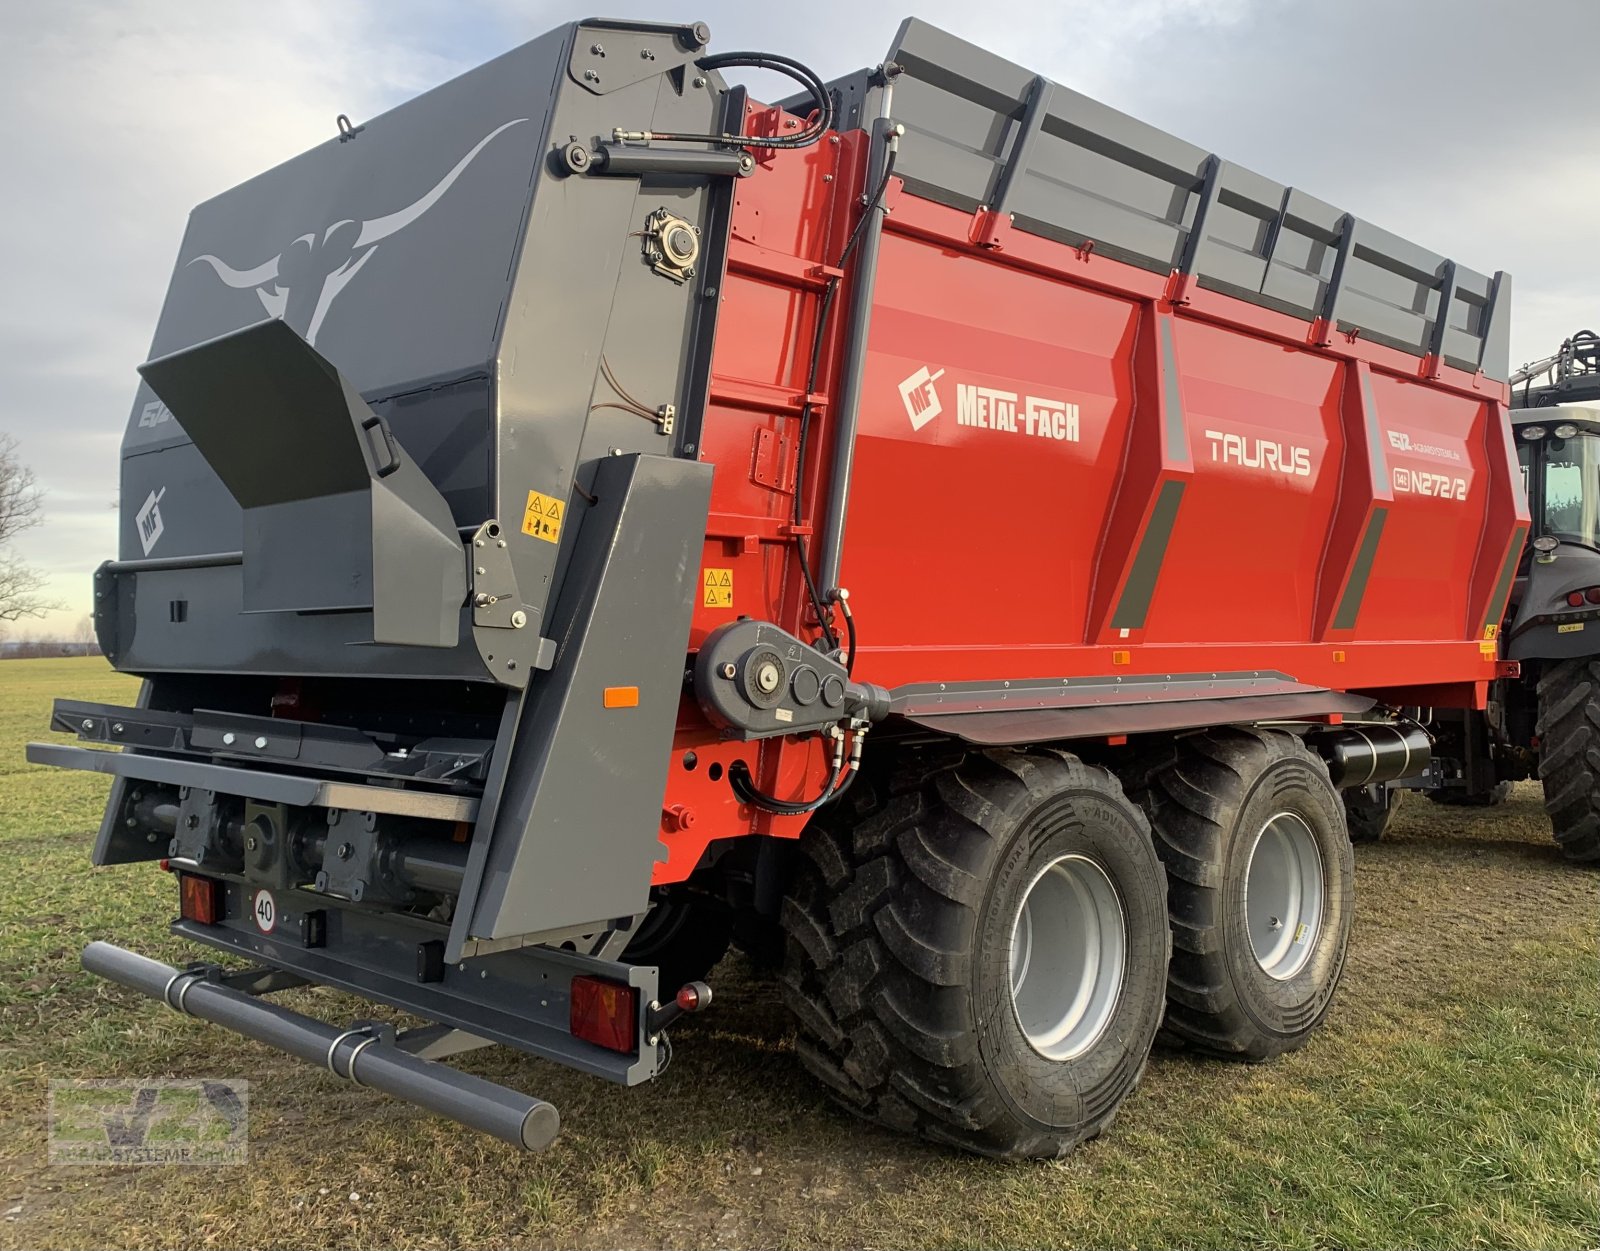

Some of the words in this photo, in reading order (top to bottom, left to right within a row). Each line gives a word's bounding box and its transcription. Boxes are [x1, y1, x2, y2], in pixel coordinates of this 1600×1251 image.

[956, 383, 1080, 443] METAL-FACH
[1205, 429, 1311, 476] TAURUS
[1411, 470, 1466, 501] N272/2
[257, 898, 273, 922] 40
